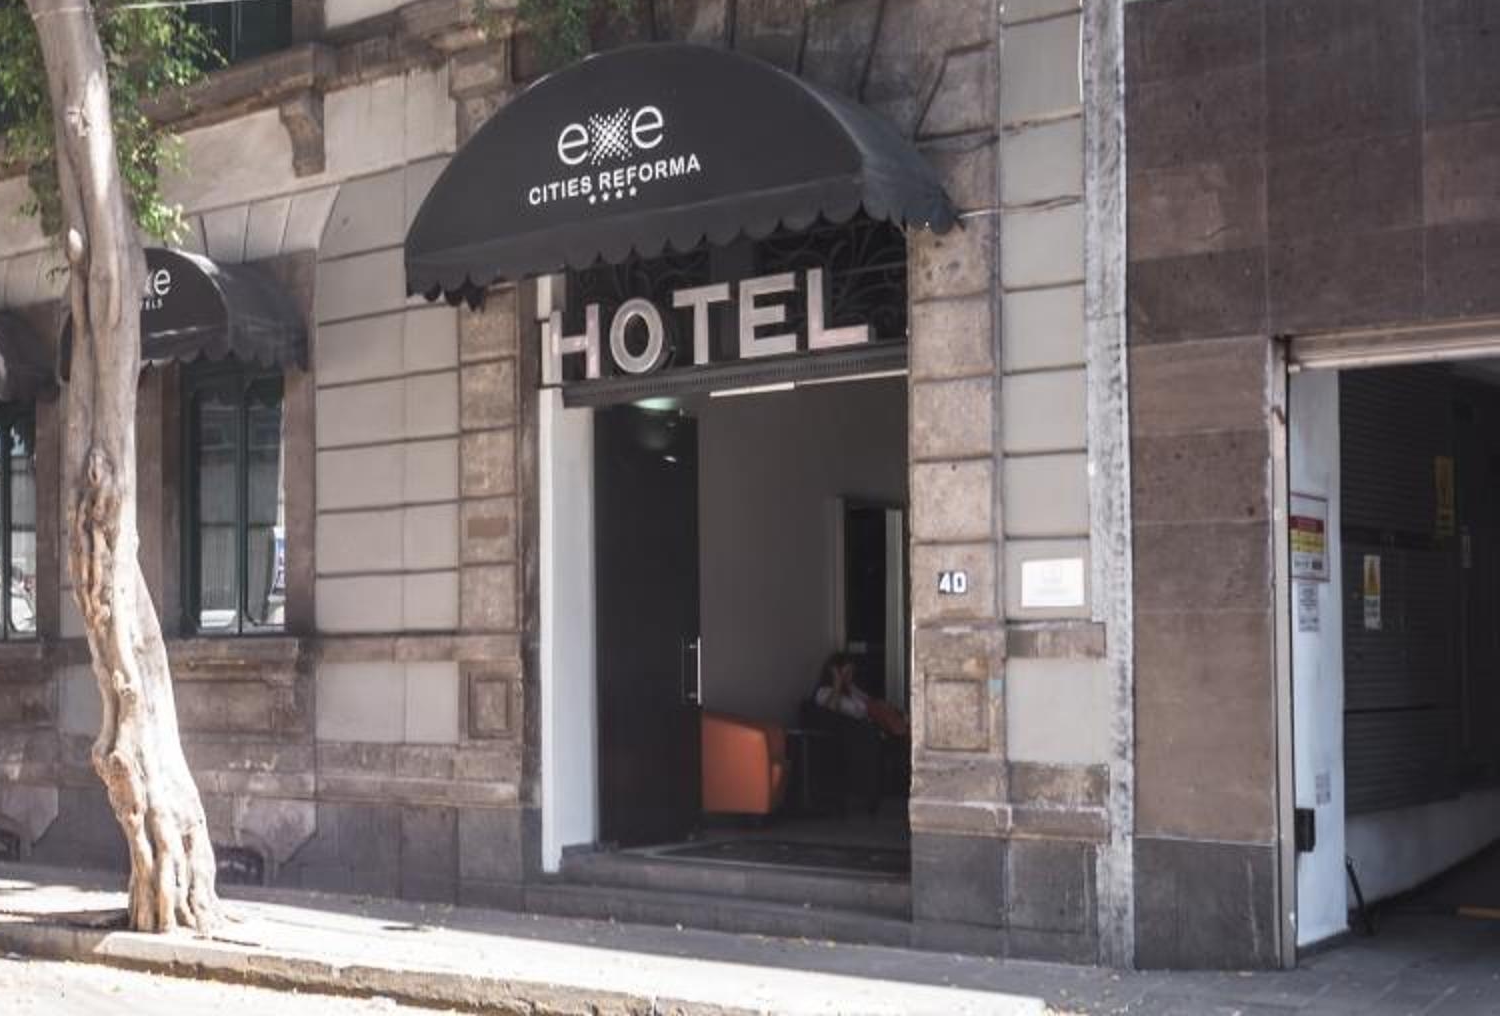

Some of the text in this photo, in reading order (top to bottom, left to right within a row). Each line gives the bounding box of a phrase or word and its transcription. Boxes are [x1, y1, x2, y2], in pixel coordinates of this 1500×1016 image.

[557, 105, 665, 165] exe
[528, 152, 701, 206] CITIES REFORMA
[545, 267, 869, 384] HOTEL
[939, 571, 967, 593] 40
